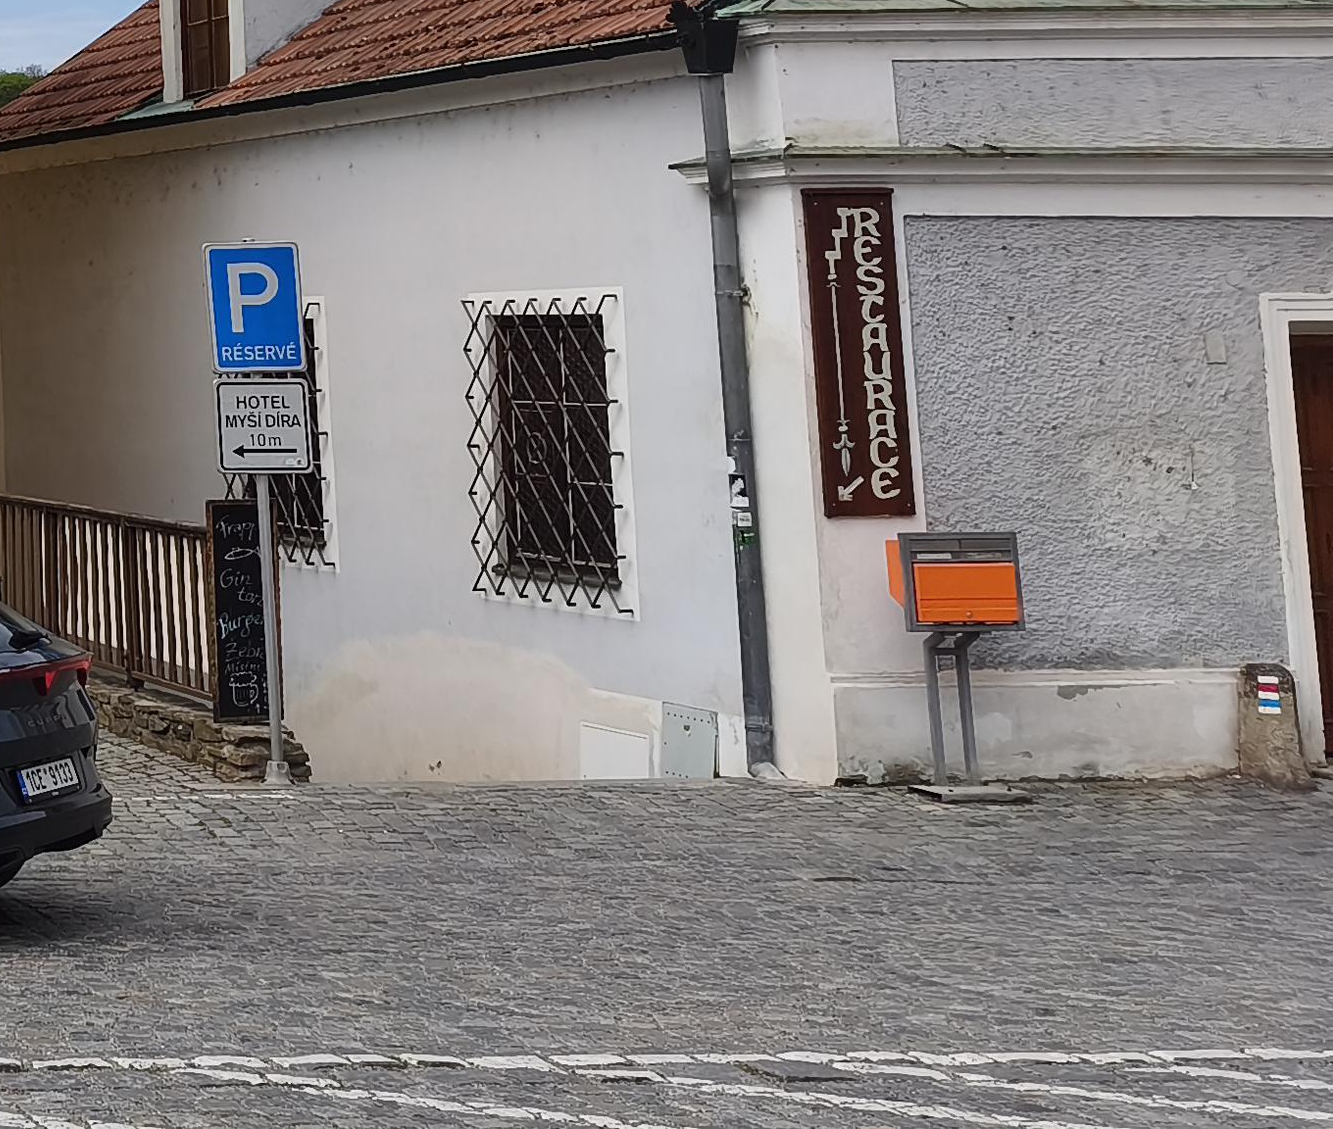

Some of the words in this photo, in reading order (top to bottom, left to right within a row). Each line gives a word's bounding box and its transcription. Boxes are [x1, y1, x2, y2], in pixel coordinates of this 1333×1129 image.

[226, 262, 279, 333] P
[221, 341, 297, 361] RÉSERVÉ
[852, 207, 900, 500] RESTAURACE
[236, 395, 291, 409] HOTEL
[225, 411, 262, 428] MYŠÍ
[265, 411, 302, 428] DÍRA
[219, 568, 253, 589] Gin
[237, 586, 264, 607] ton
[218, 611, 264, 640] Burge
[25, 770, 47, 792] 1CE
[48, 762, 74, 787] 9133
